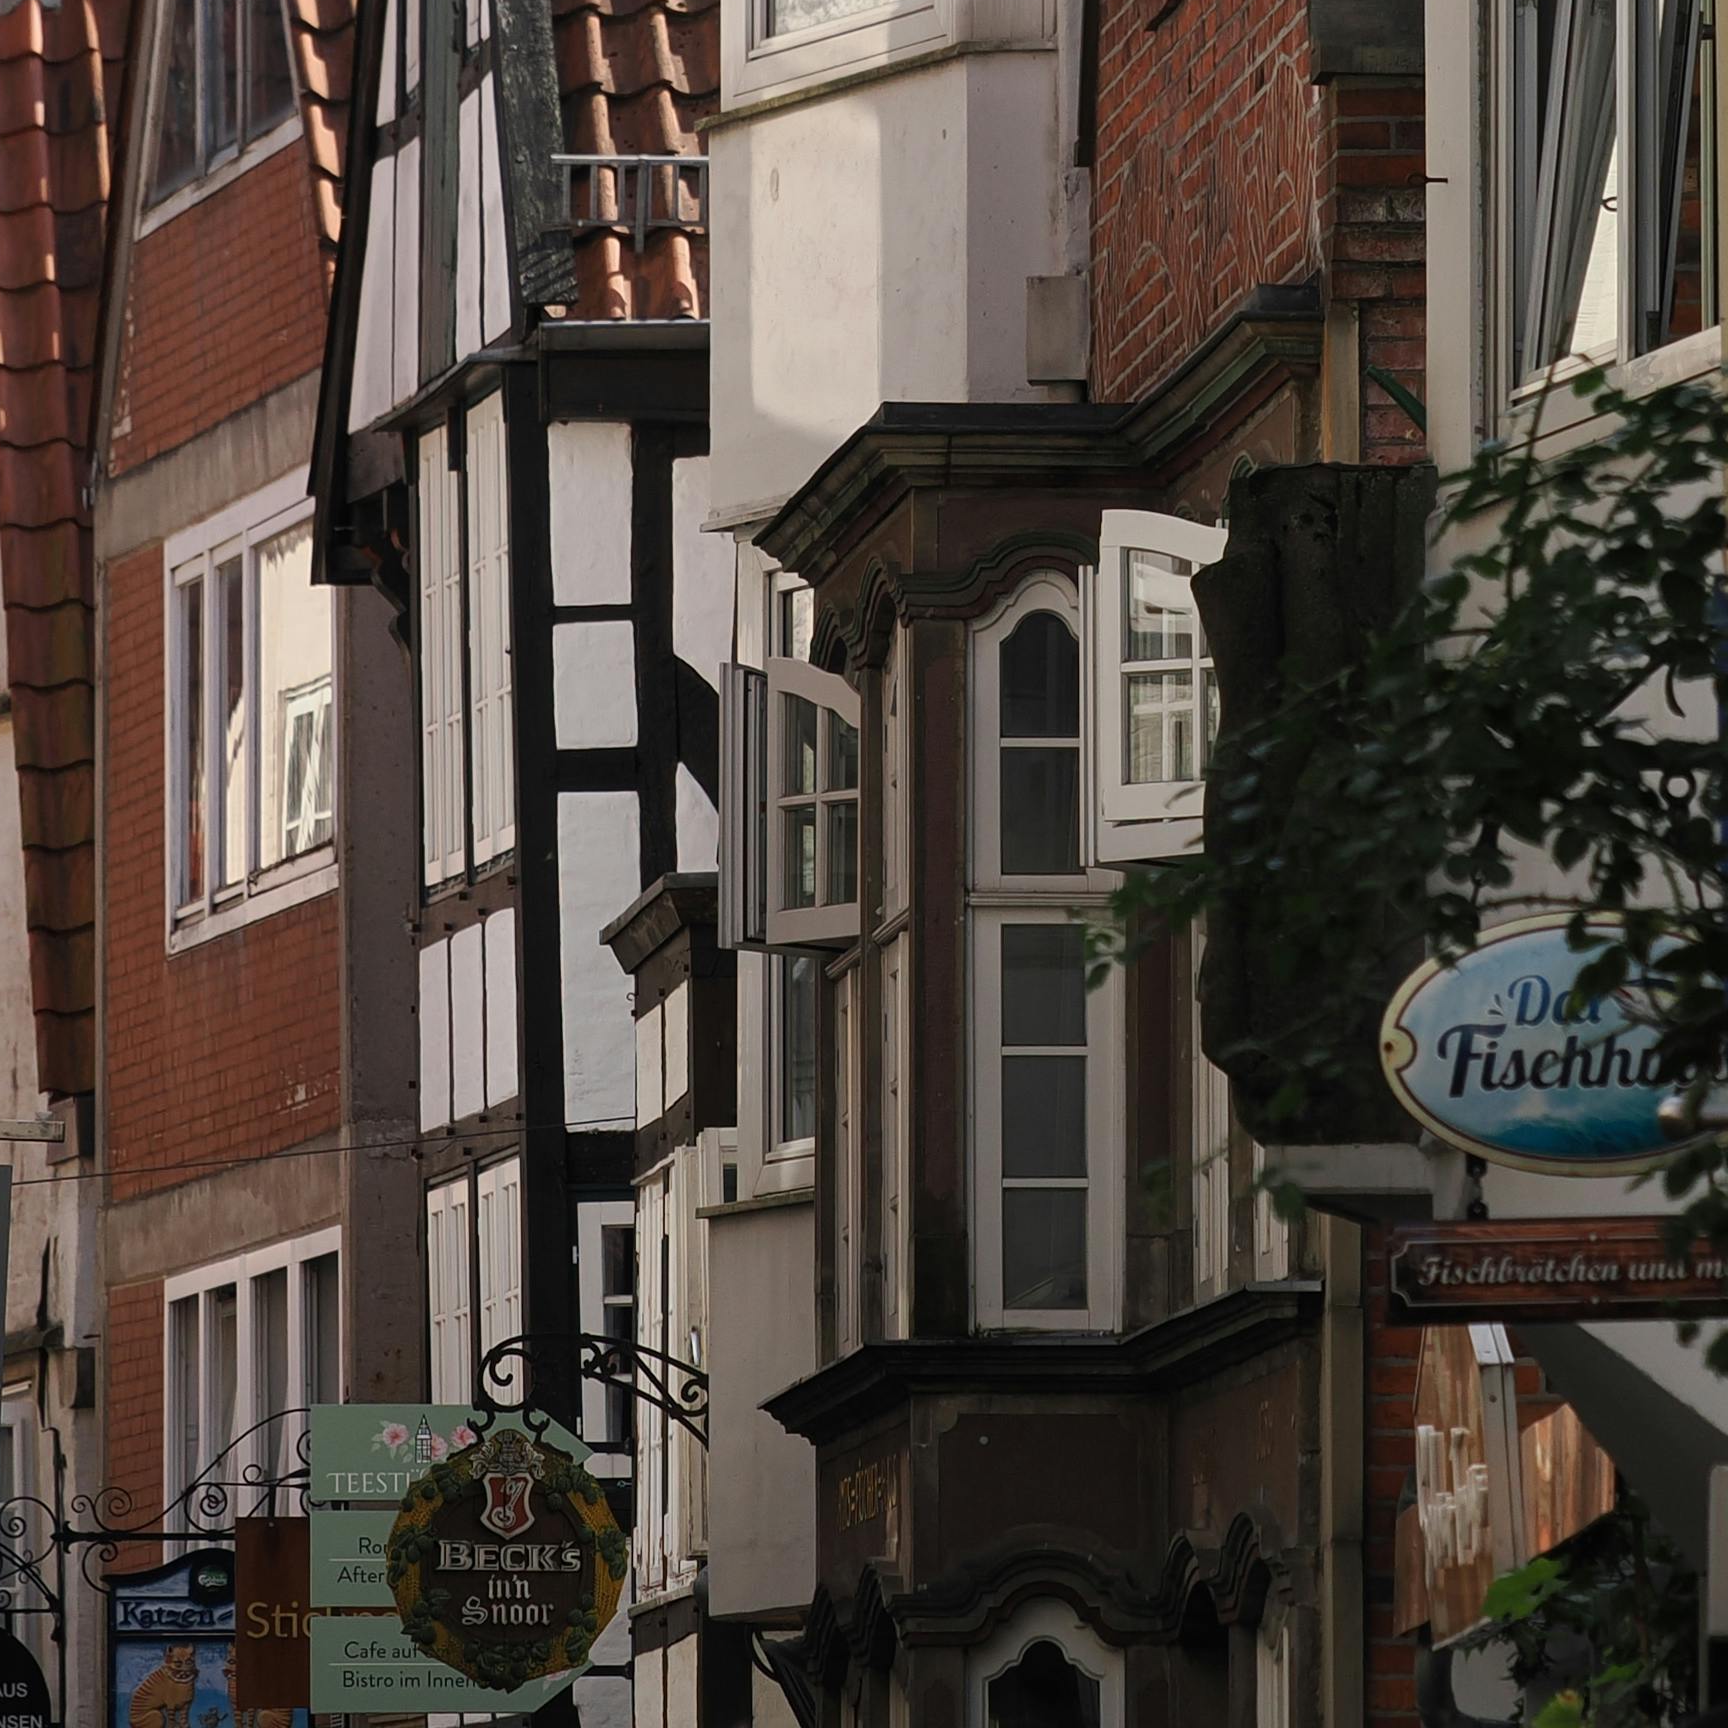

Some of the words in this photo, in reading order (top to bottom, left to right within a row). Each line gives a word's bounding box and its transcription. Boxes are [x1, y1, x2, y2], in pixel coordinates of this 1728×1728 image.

[1417, 1252, 1620, 1288] Fischbrötchen
[337, 1565, 385, 1584] After
[461, 1595, 555, 1626] Snoor
[344, 1640, 386, 1659] Cafe
[343, 1669, 393, 1688] Bistro
[399, 1669, 421, 1688] im
